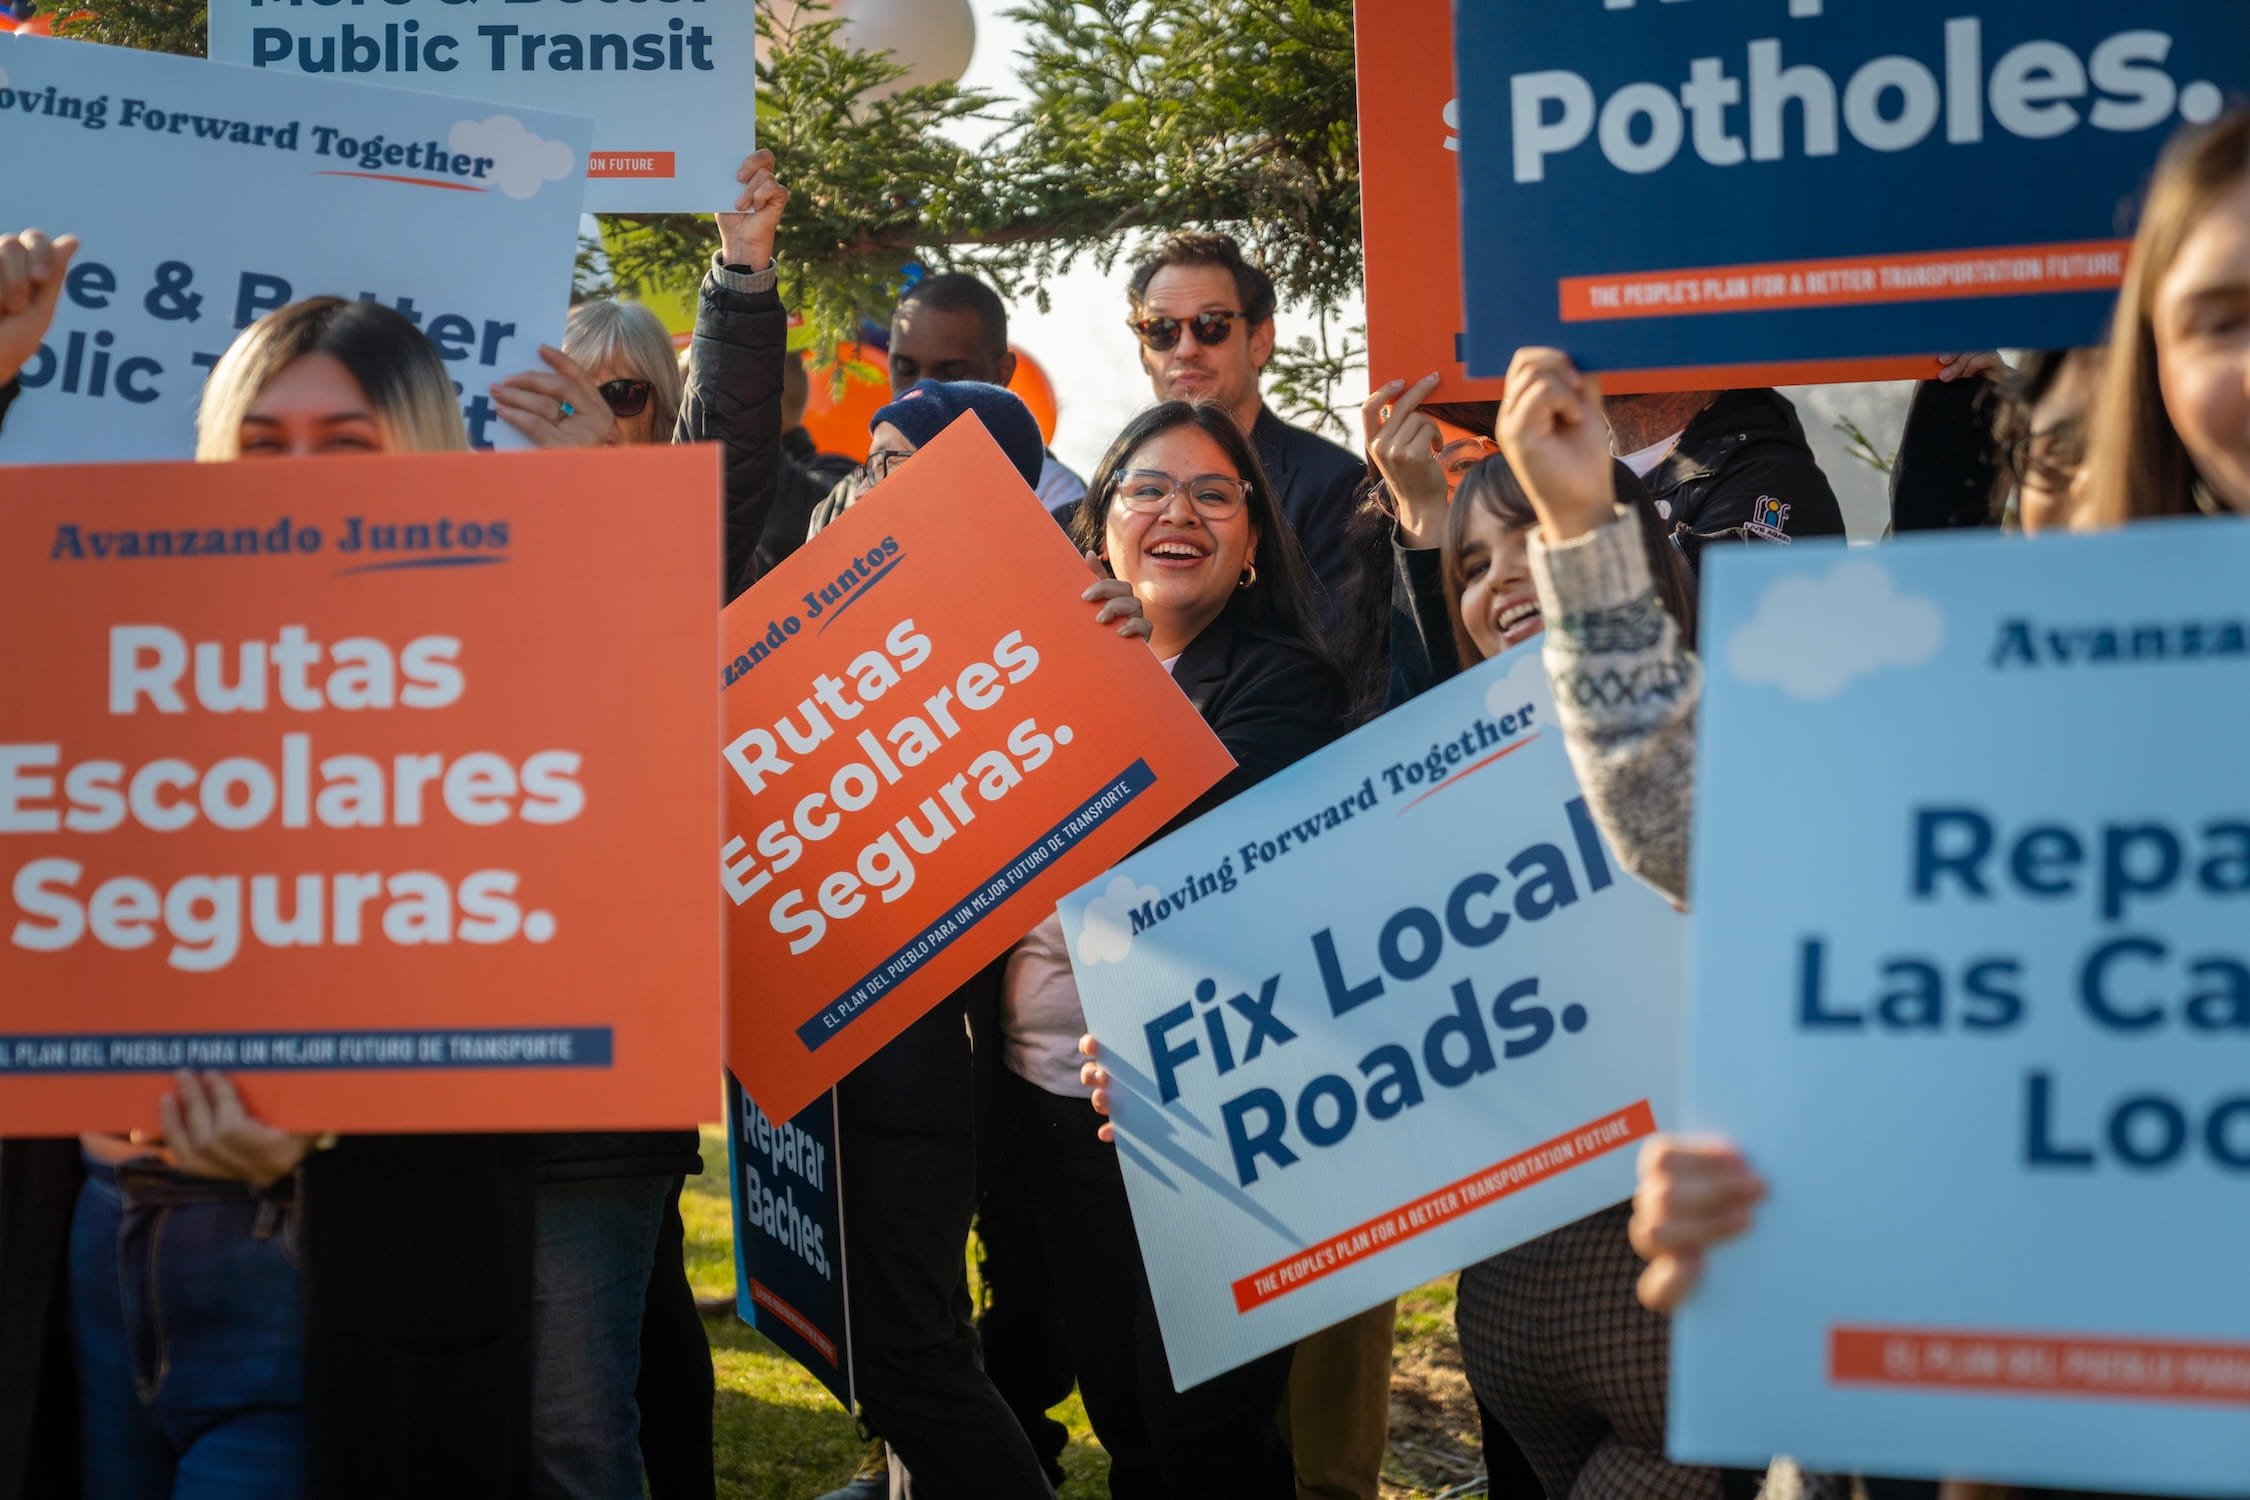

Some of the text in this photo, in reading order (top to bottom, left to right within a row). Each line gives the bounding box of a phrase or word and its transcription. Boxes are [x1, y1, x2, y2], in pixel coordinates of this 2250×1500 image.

[253, 17, 715, 74] Public Transit
[1510, 15, 2224, 184] Potholes.
[117, 97, 301, 151] Forward
[311, 124, 496, 180] Together
[609, 157, 654, 172] FUTURE
[143, 260, 205, 324] &
[232, 271, 516, 367] Ber
[1589, 252, 2122, 309] THE PEOPLE'S PLAN FOR A BETTER TRANSPORTATION FUTURE
[50, 516, 511, 560] Avanzando Juntos
[108, 624, 465, 715] Rutas
[720, 535, 899, 692] zando Juntos
[722, 617, 932, 795] Rutas
[0, 734, 585, 833] Escolares
[722, 630, 1040, 905] Escolares
[1128, 701, 1537, 937] Moving Forward Together
[768, 714, 1074, 955] Seguras.
[1911, 804, 2250, 923] Repa
[11, 858, 556, 972] Seguras.
[822, 780, 1131, 1029] EL PLAN DEL PUEBLO PARA UN MEJOR FUTURO DE TRANSPORTE
[1142, 796, 1613, 1105] Fix Local
[1797, 935, 2029, 1032] Las
[16, 1039, 62, 1066] PLAN
[69, 1039, 106, 1065] DEL
[110, 1038, 185, 1065] PUEBLO
[187, 1038, 235, 1064] PARA
[240, 1037, 264, 1063] UN
[271, 1036, 334, 1063] MEJOR
[339, 1036, 411, 1062] FUTURO
[418, 1035, 443, 1062] DE
[449, 1034, 574, 1061] TRANSPORTE
[1220, 977, 1588, 1188] Roads.
[741, 1085, 825, 1193] Reparar
[745, 1163, 831, 1281] Baches.
[1254, 1116, 1631, 1297] THE PEOPLE'S PLAN FOR A BETTER TRANSPORTATION FUTURE
